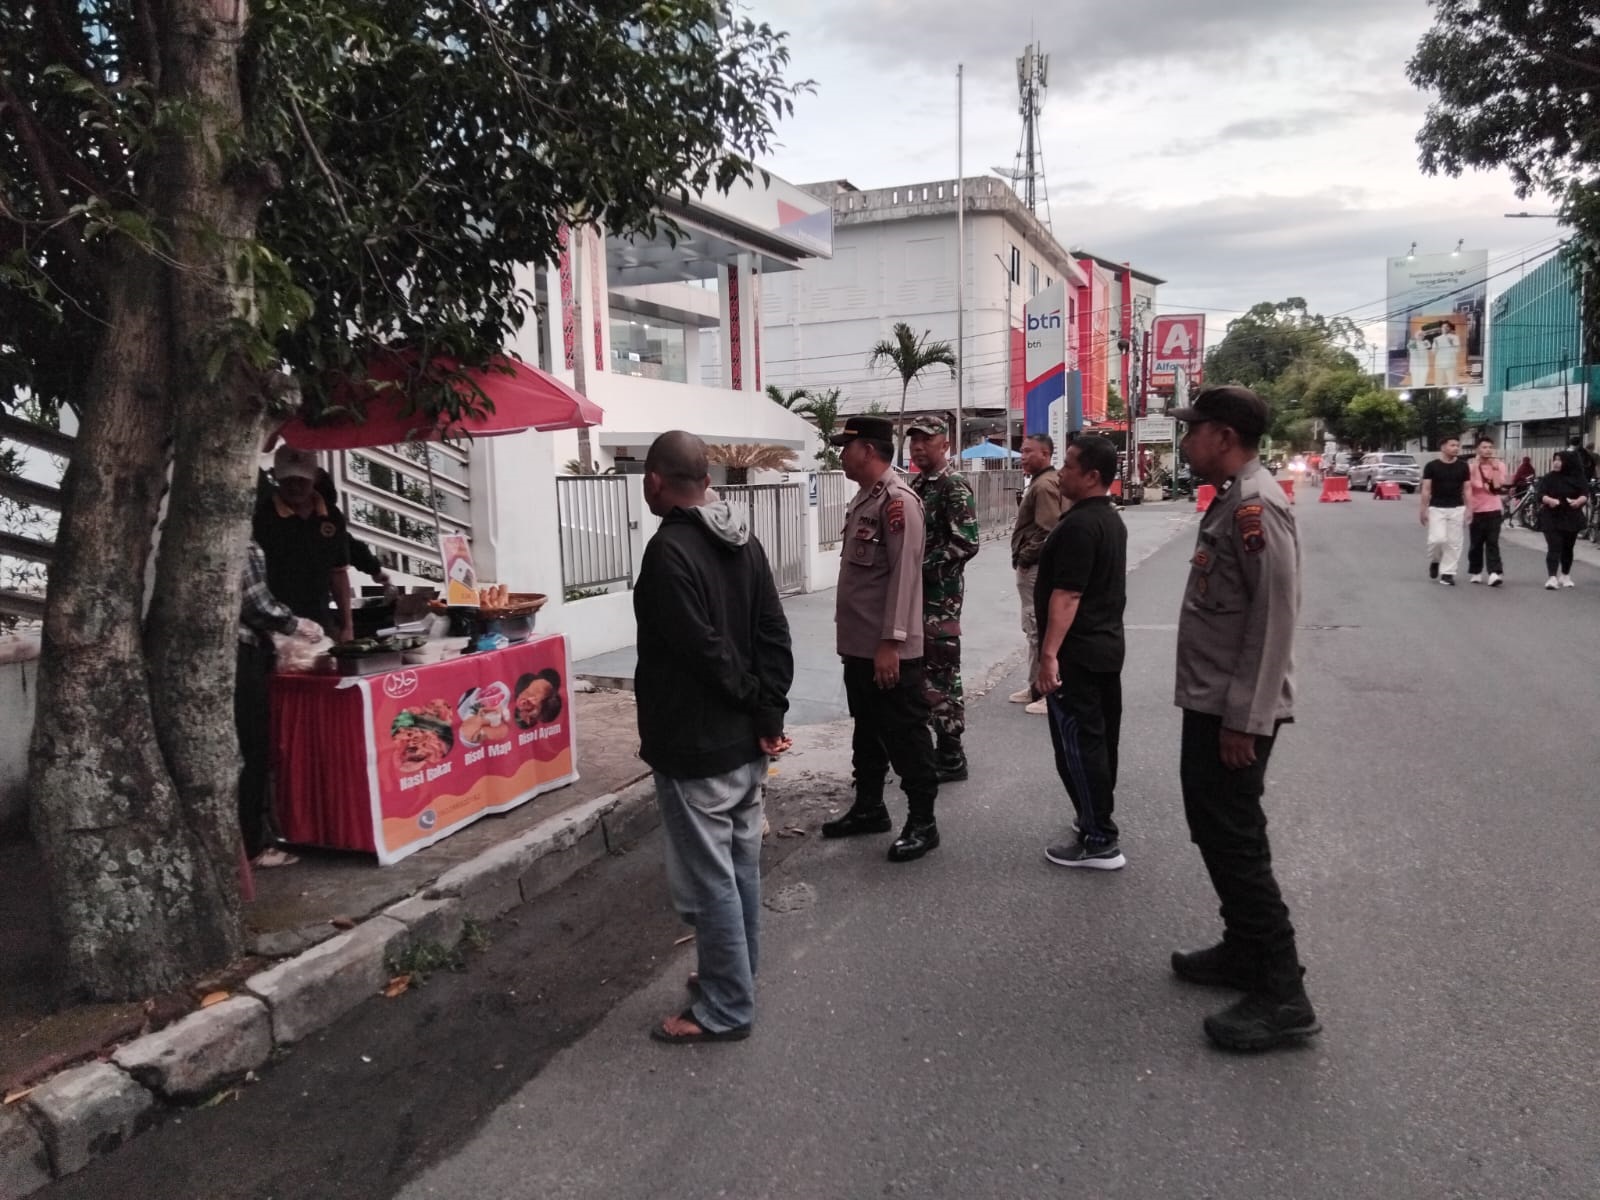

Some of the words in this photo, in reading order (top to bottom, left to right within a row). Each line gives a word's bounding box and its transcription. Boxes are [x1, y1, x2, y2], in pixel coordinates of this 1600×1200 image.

[1027, 309, 1060, 330] btn
[1027, 341, 1041, 349] btn
[1162, 323, 1190, 356] A
[539, 724, 561, 739] Ayam
[400, 770, 424, 791] Nasi
[426, 761, 452, 782] Bakar
